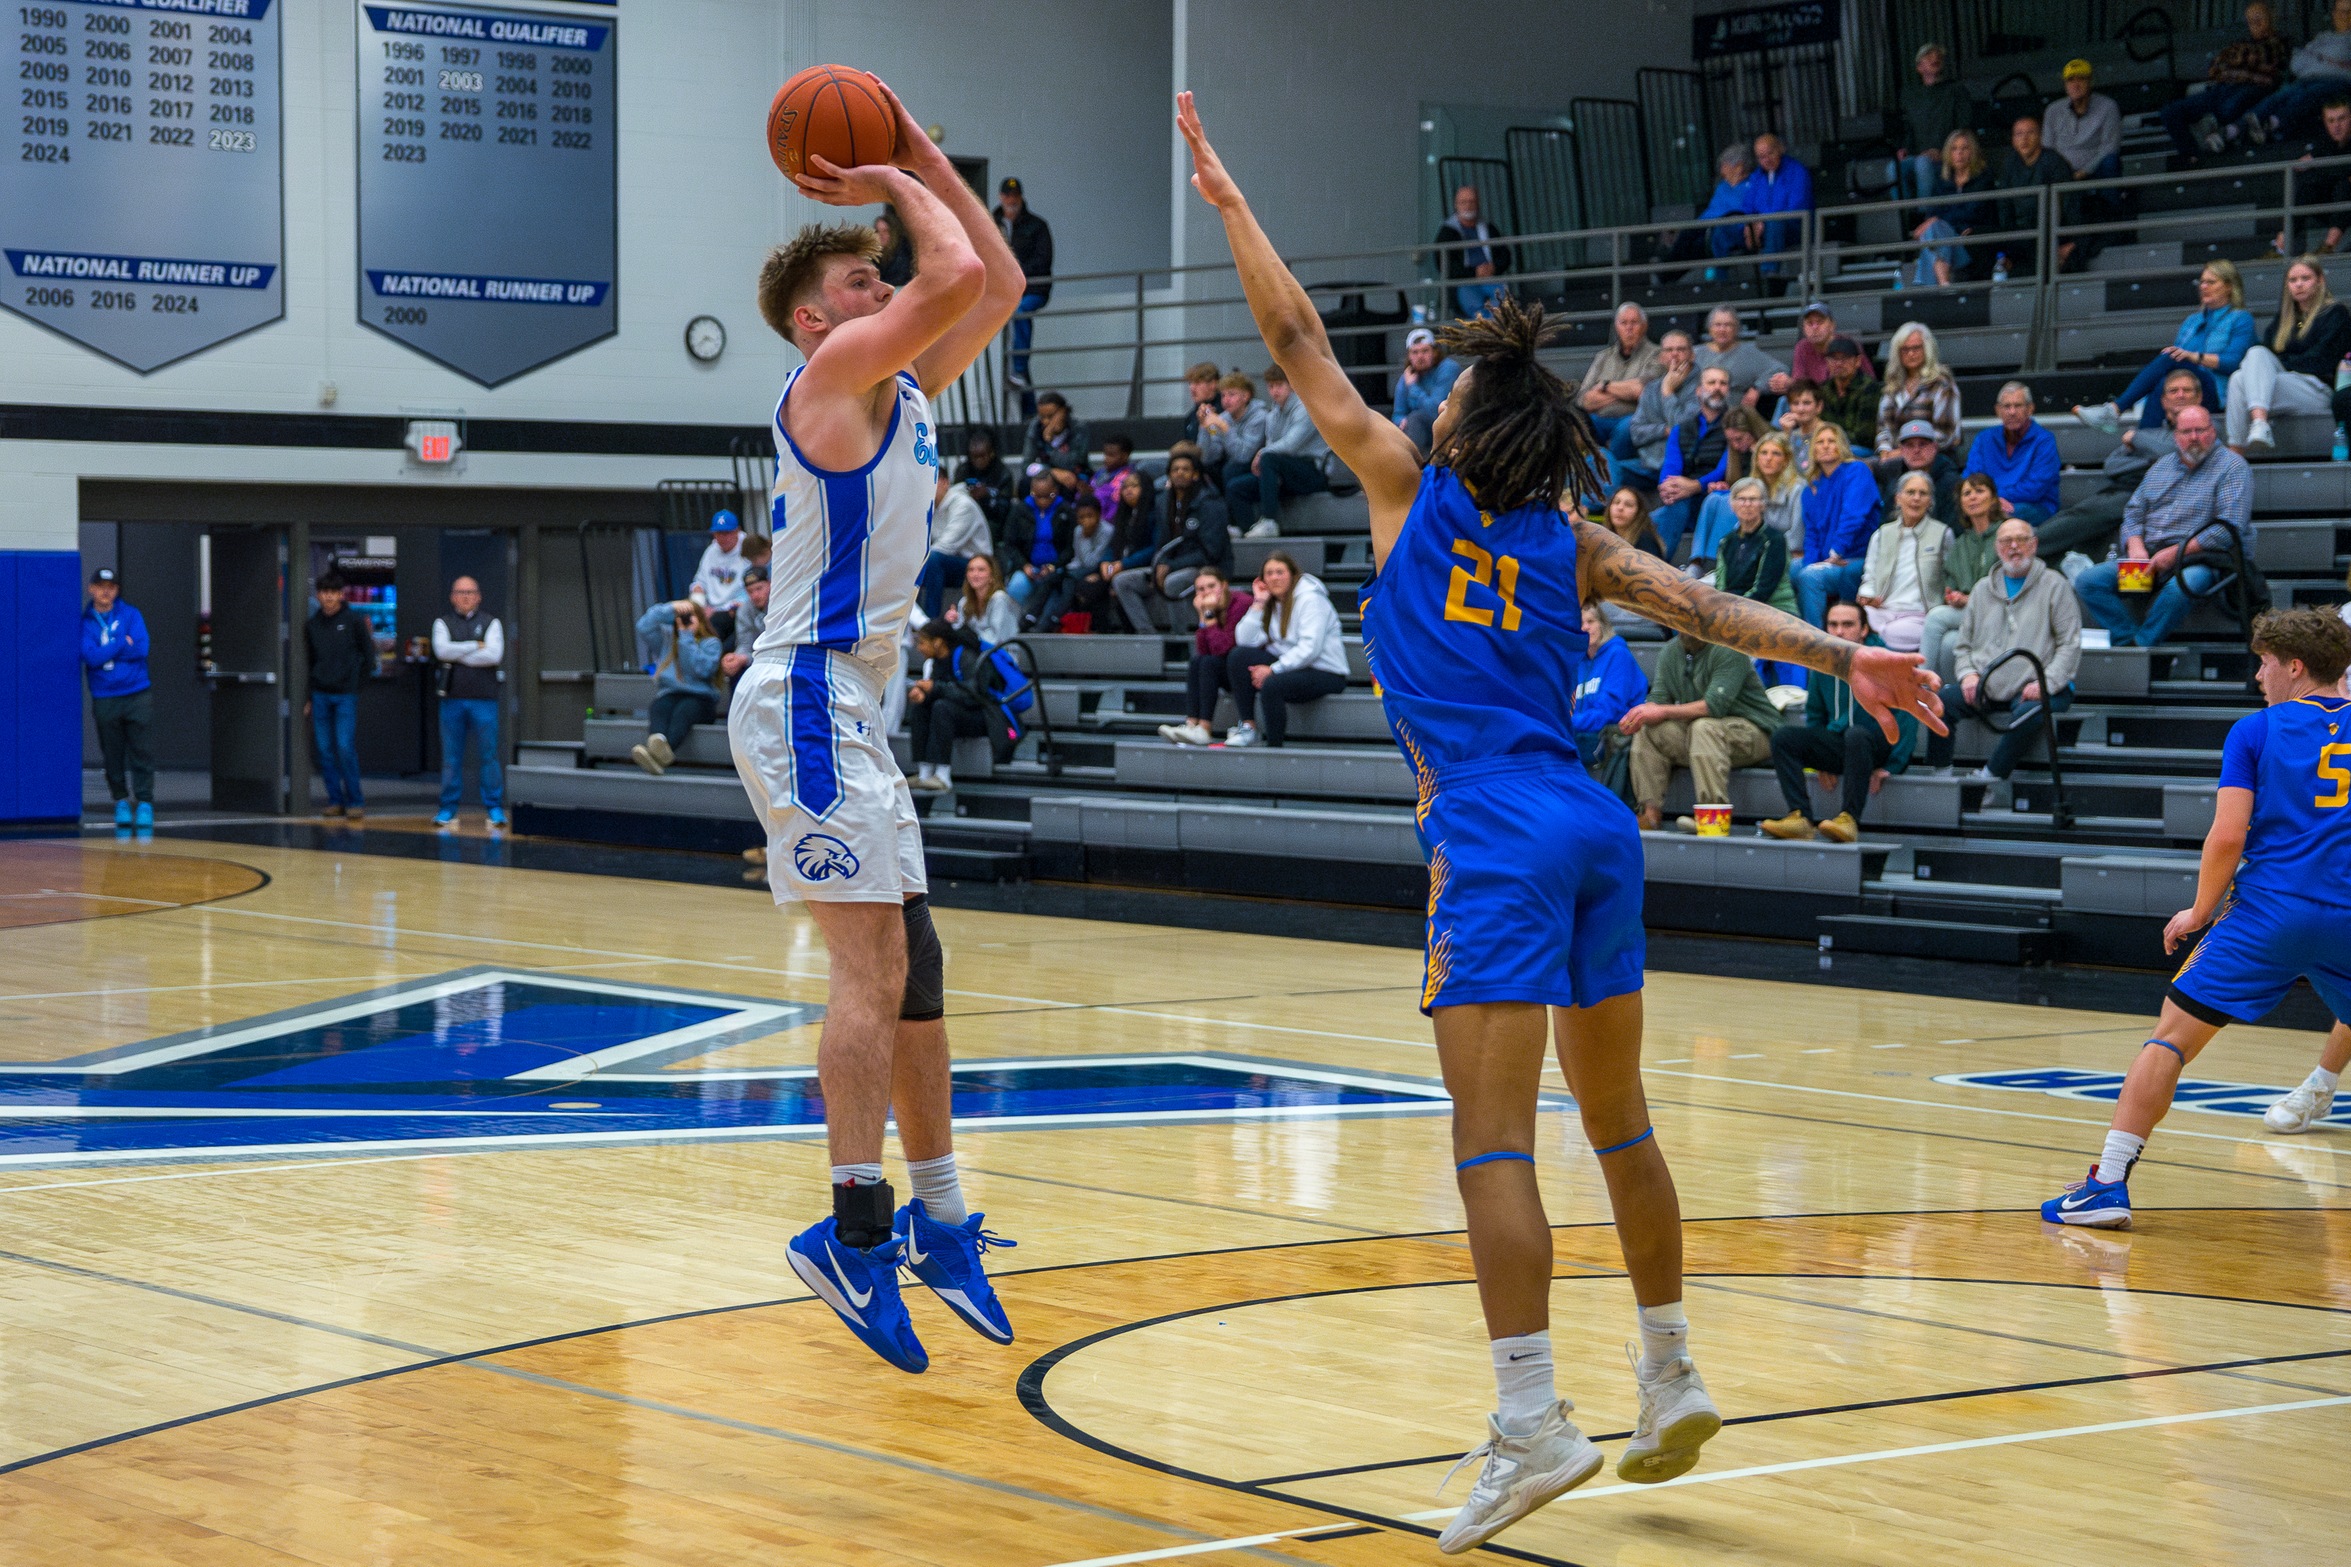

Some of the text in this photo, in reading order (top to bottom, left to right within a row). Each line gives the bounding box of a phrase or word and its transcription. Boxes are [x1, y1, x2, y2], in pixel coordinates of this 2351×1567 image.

[20, 8, 252, 45] 1990 2000 2001 2004
[386, 12, 587, 46] NATIONAL QUALIFIER
[21, 35, 254, 72] 2005 2006 2007 2008
[441, 47, 480, 66] 1997
[551, 56, 591, 75] 2000
[20, 62, 254, 98] 2009 2010 2012 2013
[384, 66, 423, 85] 2001
[439, 70, 483, 91] 2003
[496, 76, 537, 95] 2004
[22, 89, 254, 124] 2015 2016 2017 2018
[384, 92, 424, 111] 2012
[441, 97, 481, 116] 2015
[497, 102, 536, 120] 2016
[23, 117, 256, 152] 2019 2021 2022 2023
[384, 118, 424, 137] 2019
[440, 122, 482, 141] 2020
[498, 127, 537, 145] 2021
[22, 144, 70, 163] 2024
[383, 144, 426, 163] 2023
[23, 255, 260, 285] NATIONAL RUNNER UP
[26, 288, 198, 313] 2006 2016 2024
[382, 275, 594, 302] NATIONAL RUNNER UP
[384, 307, 427, 325] 2000
[422, 435, 449, 461] EXIT
[1444, 538, 1522, 631] 21
[2314, 742, 2351, 808] 5
